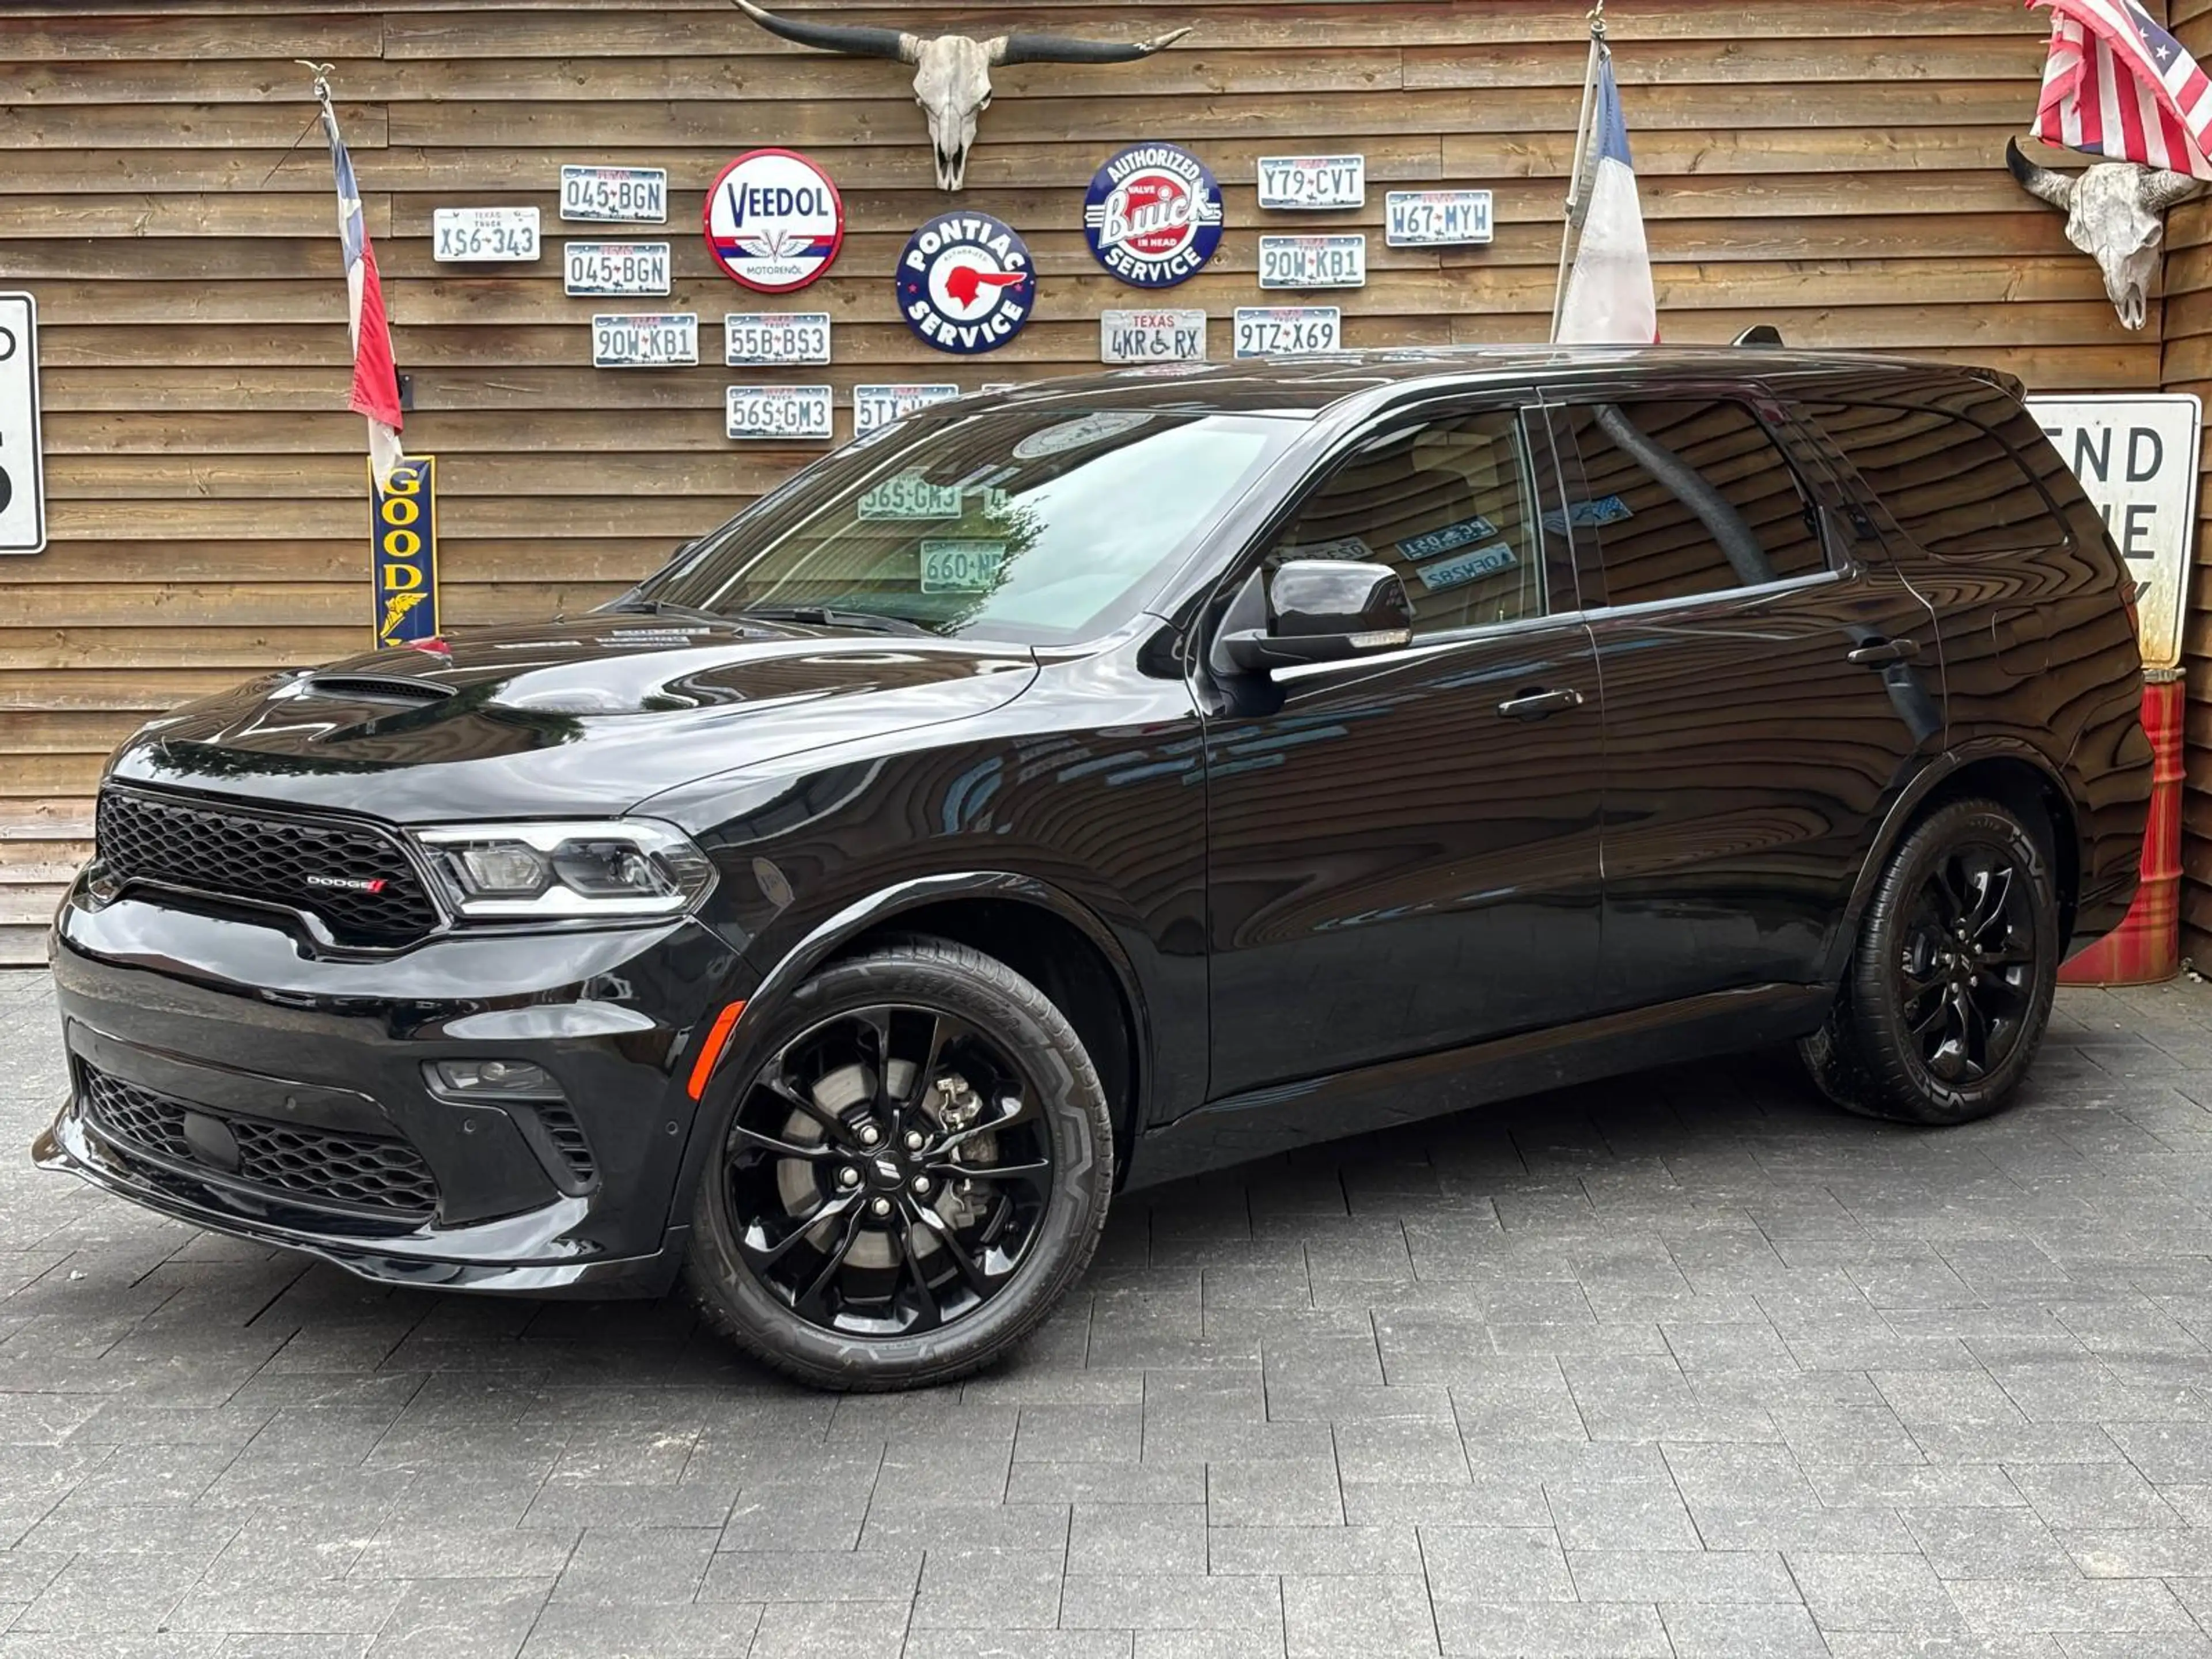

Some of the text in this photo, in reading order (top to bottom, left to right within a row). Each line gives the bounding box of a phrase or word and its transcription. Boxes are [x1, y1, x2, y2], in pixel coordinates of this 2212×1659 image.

[1107, 149, 1200, 183] AUTHORIZED
[727, 183, 828, 228] VEEDOL
[1098, 177, 1209, 249] Buick
[906, 219, 1025, 272] PONTIAC
[1150, 238, 1177, 247] HEAD
[1104, 247, 1202, 282] SERVICE
[908, 299, 1024, 348] SERVICE
[1134, 315, 1175, 328] TEXAS
[1112, 329, 1198, 356] 4KR RX
[2043, 427, 2164, 482] ND
[381, 468, 423, 590] GOOD
[307, 876, 372, 889] DODGE
